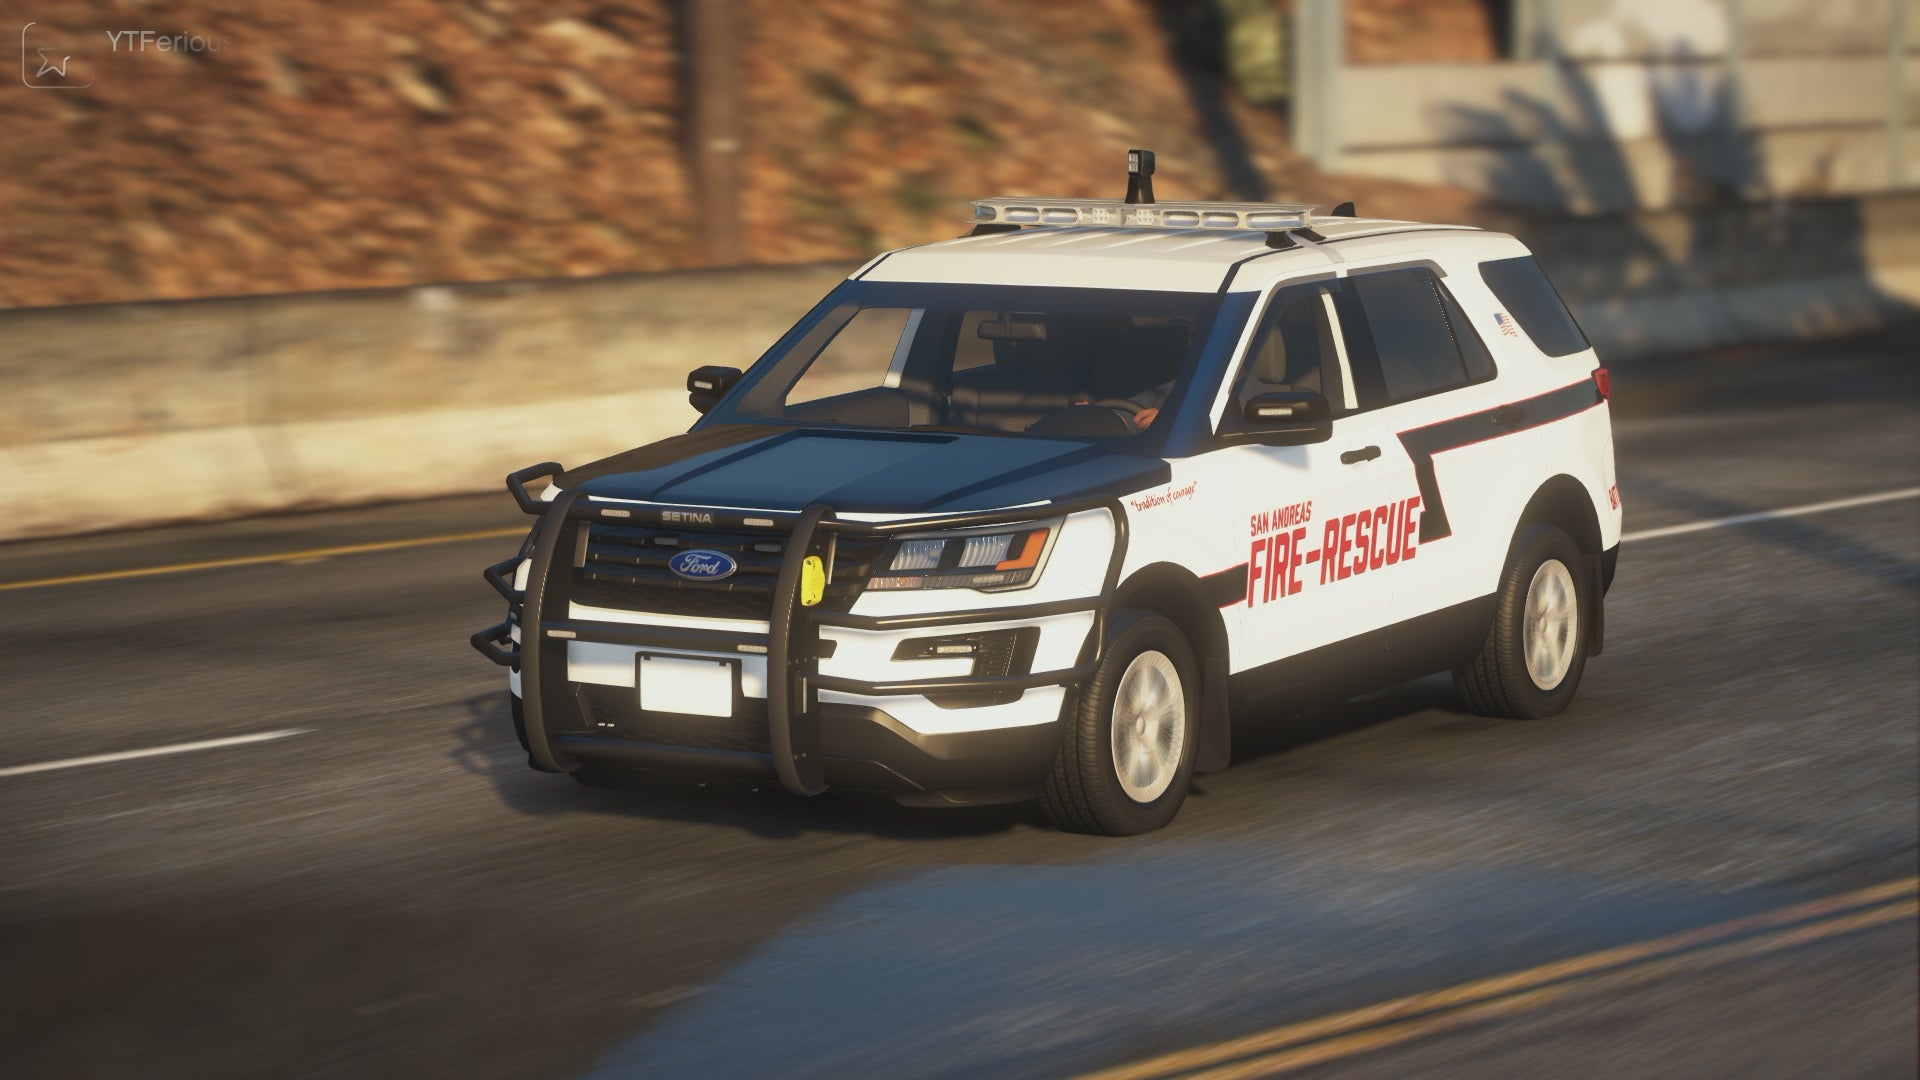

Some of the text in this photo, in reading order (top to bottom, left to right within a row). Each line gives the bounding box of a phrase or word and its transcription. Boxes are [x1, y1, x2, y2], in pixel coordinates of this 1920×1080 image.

[662, 511, 712, 523] SETINA
[1250, 500, 1312, 537] SAN ANDREAS
[680, 553, 720, 574] Ford
[1247, 496, 1421, 608] FIRE-RESCUE
